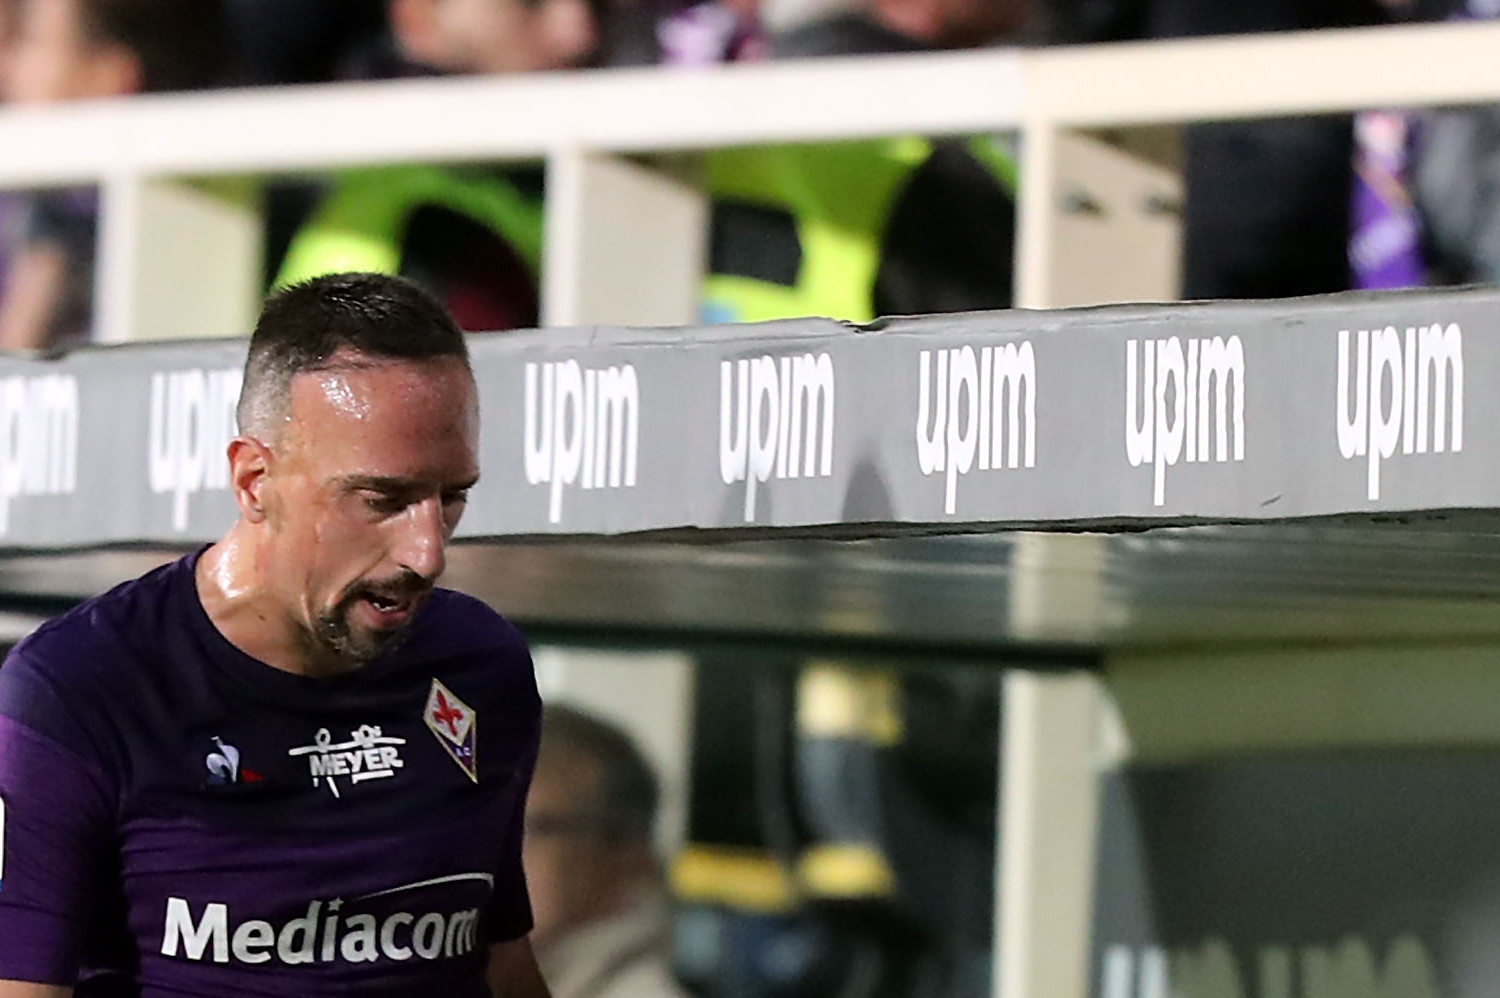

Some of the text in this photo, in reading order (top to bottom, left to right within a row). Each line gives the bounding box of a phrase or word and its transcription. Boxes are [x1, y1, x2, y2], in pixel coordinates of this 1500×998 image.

[524, 359, 639, 523] upim
[720, 352, 835, 522] upim
[916, 340, 1036, 515] upim
[1125, 335, 1245, 506] upim
[1336, 322, 1464, 500] upim
[309, 746, 404, 777] MEYER
[161, 896, 480, 966] Mediacom
